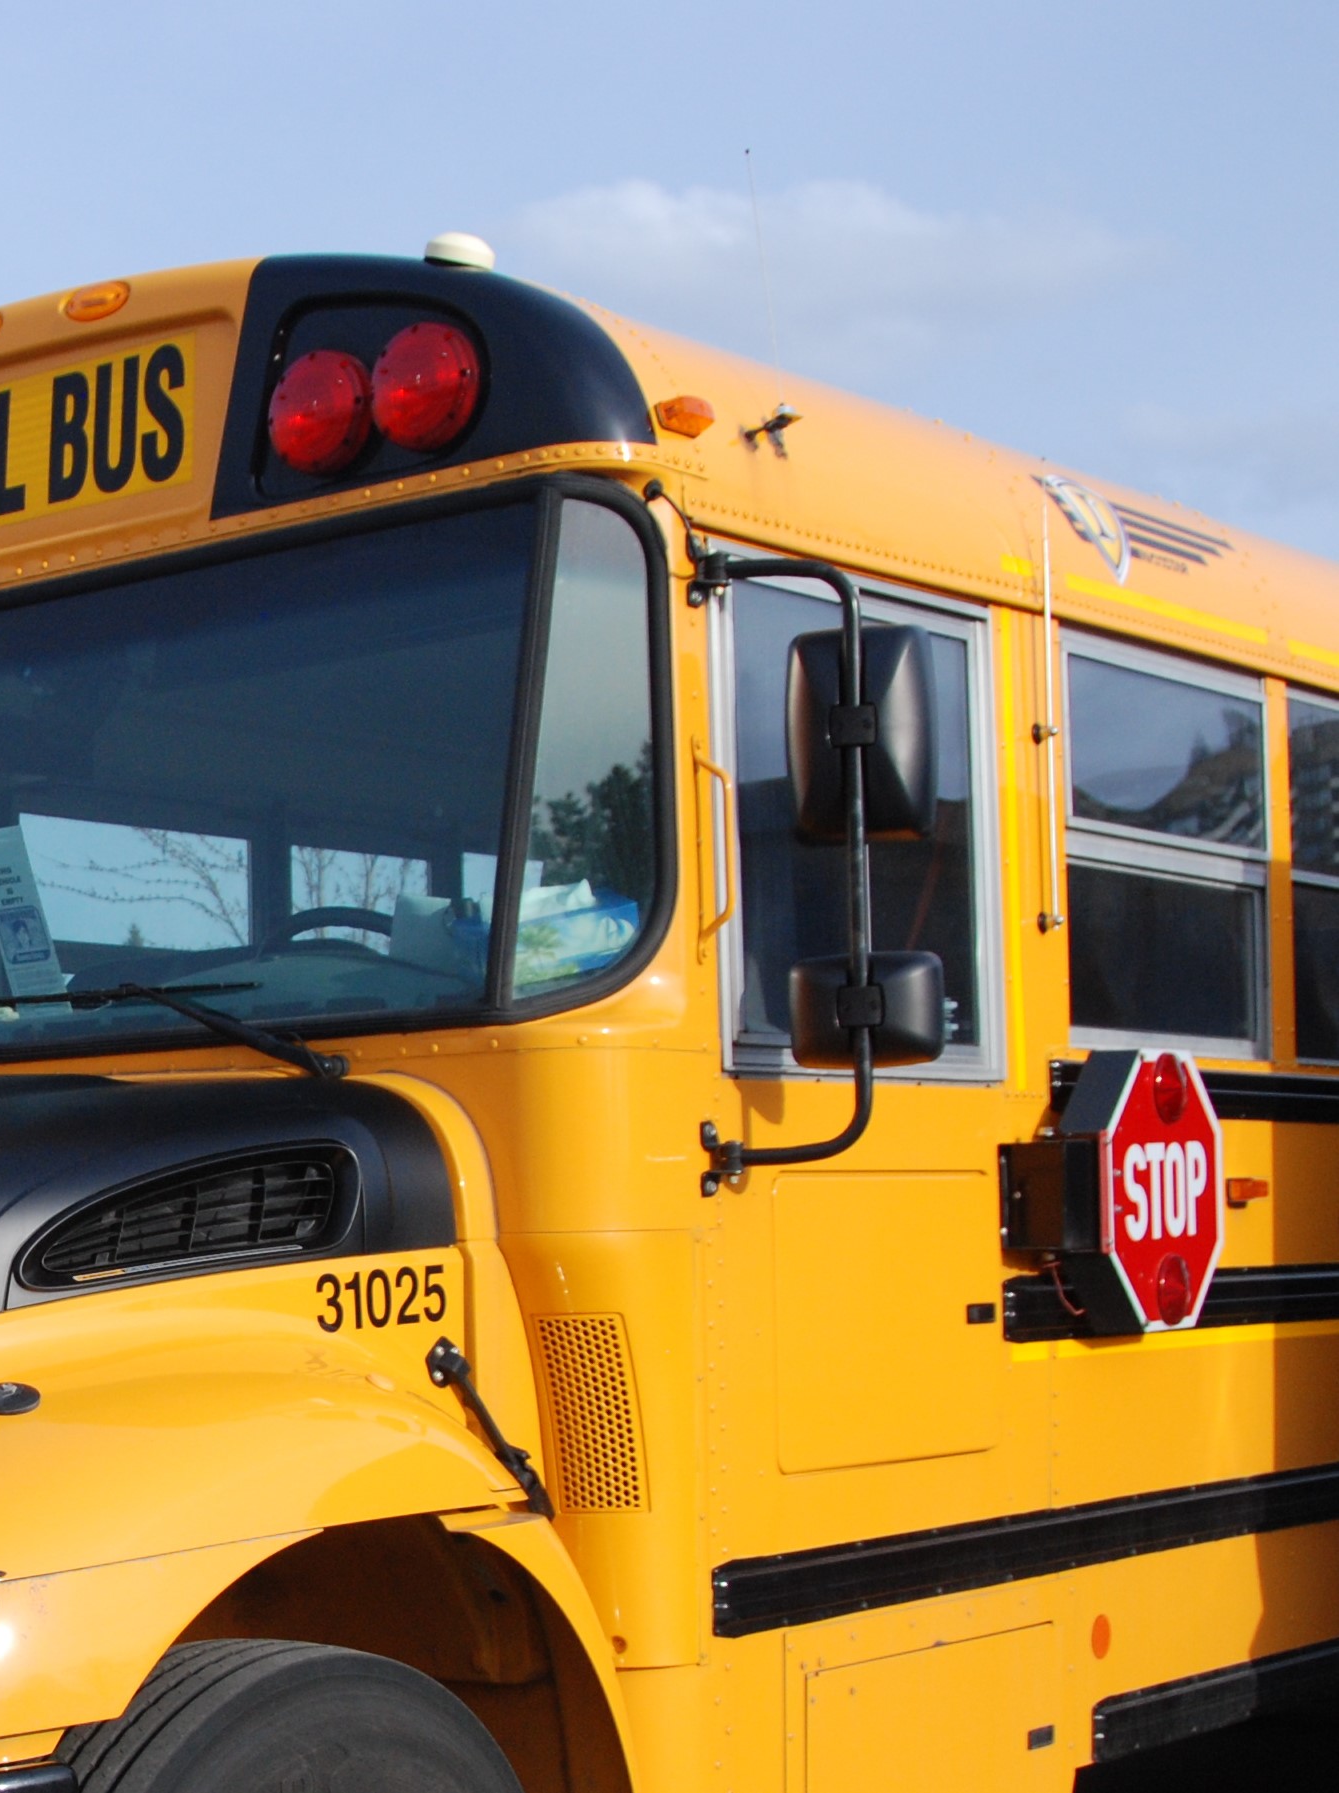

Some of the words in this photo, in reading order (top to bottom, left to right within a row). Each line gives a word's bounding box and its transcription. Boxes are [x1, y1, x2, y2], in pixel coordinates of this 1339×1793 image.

[48, 344, 186, 504] BUS
[1123, 1141, 1207, 1241] STOP
[316, 1264, 446, 1333] 31025
